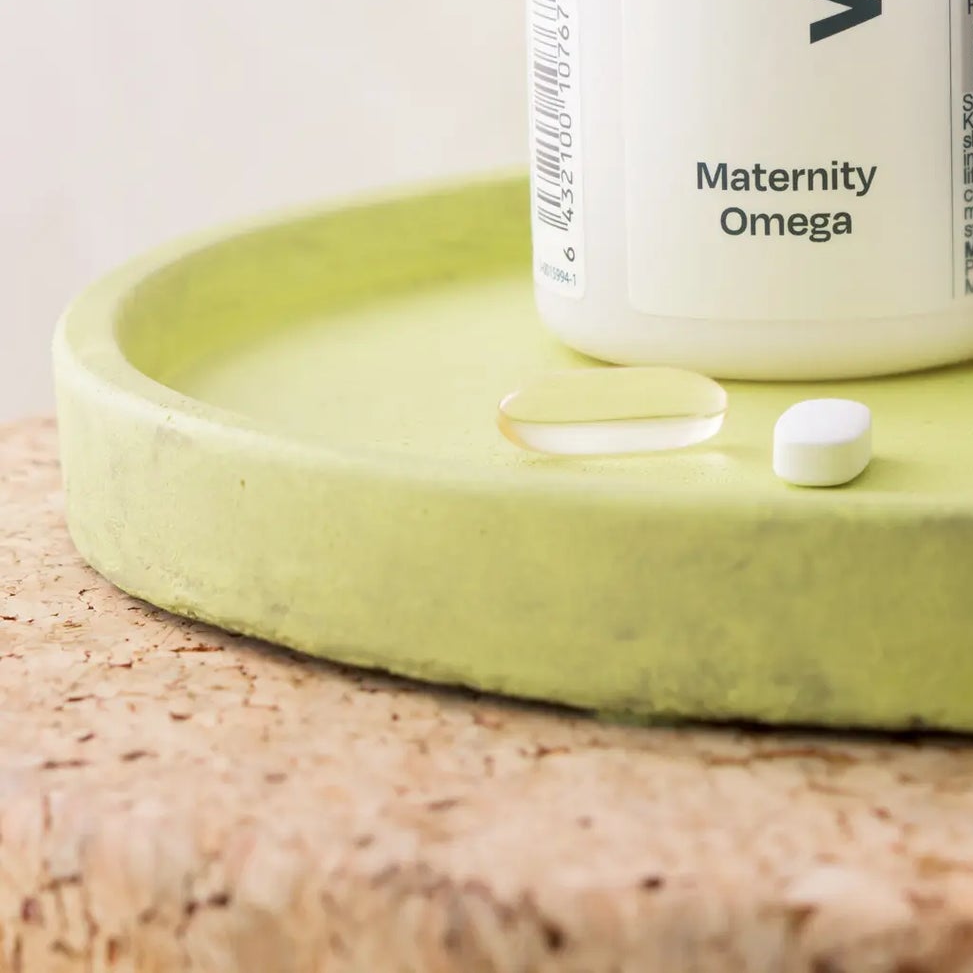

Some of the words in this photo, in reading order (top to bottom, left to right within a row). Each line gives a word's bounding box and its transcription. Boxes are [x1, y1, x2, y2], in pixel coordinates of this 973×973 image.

[556, 112, 575, 223] 432100
[697, 160, 877, 196] Maternity
[720, 206, 853, 242] Omega
[563, 246, 576, 262] 6
